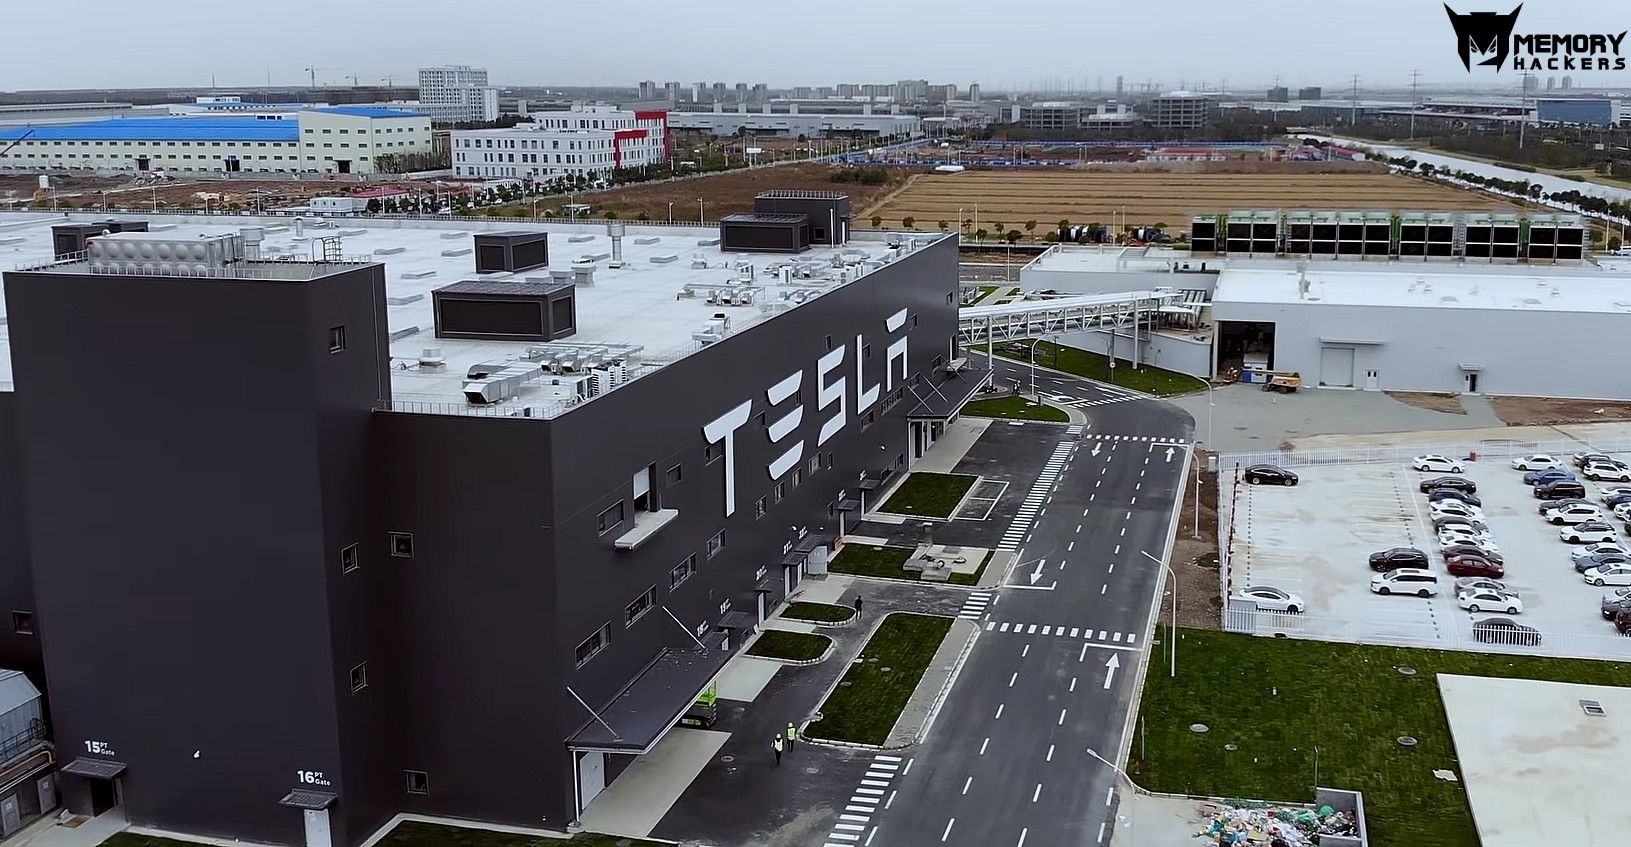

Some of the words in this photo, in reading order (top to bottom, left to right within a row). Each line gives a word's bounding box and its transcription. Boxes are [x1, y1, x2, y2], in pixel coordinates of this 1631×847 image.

[703, 307, 908, 518] TESLA
[84, 740, 100, 753] 15
[100, 748, 115, 756] Gate
[297, 770, 315, 784] 16
[314, 778, 331, 786] Gate
